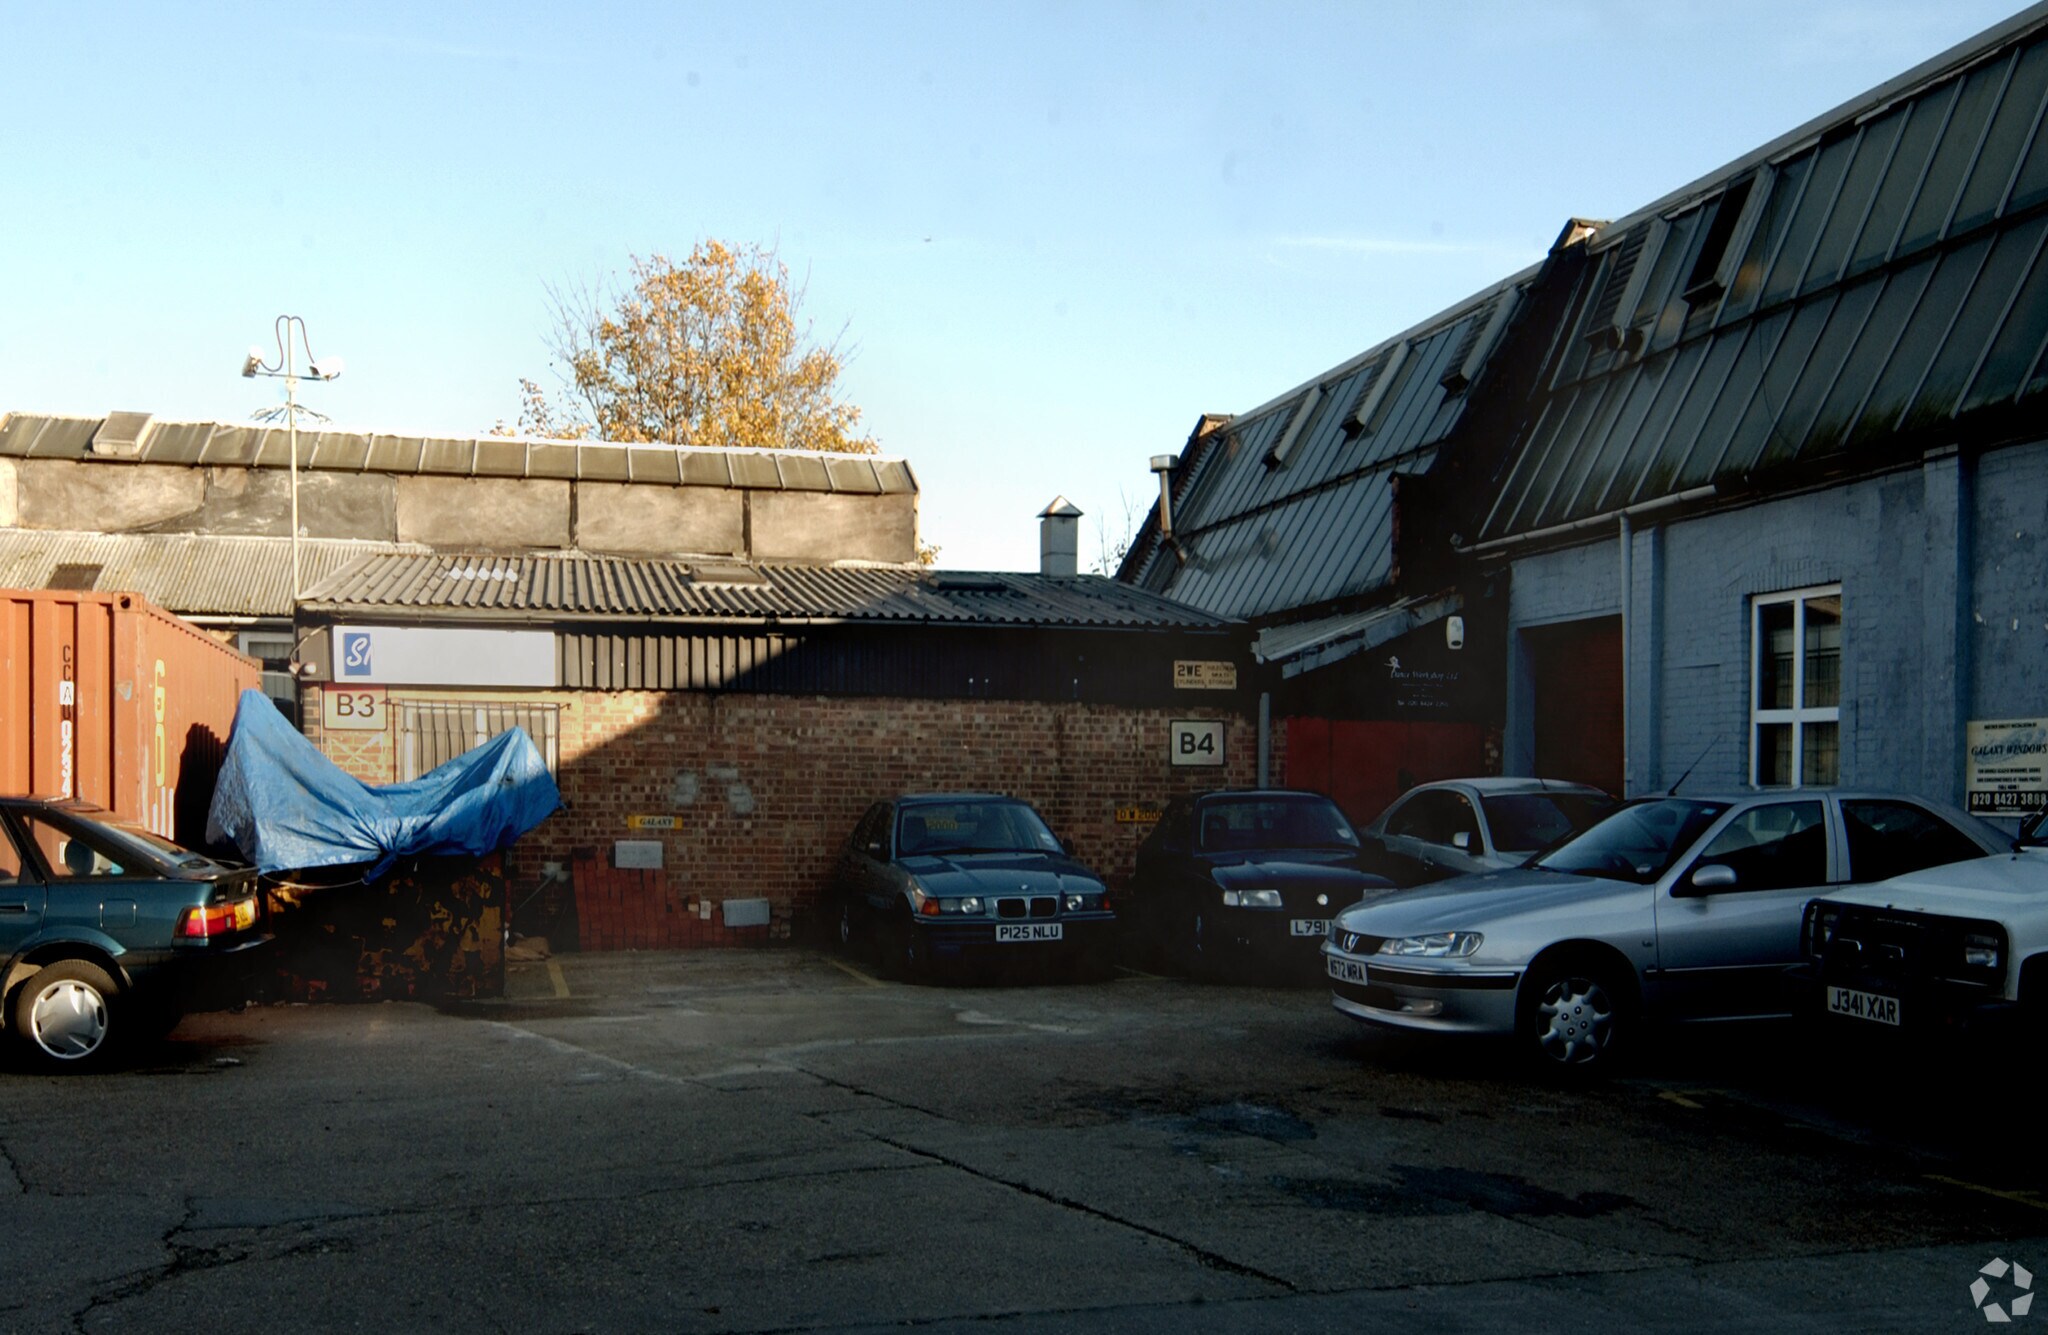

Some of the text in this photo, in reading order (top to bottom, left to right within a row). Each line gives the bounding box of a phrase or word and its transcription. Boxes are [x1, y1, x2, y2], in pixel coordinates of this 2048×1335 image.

[1177, 664, 1202, 677] 2WE
[337, 693, 375, 718] B3
[1180, 732, 1215, 755] B4
[1971, 743, 2048, 756] GALAXY WINDOWS
[1972, 792, 1991, 805] 020
[1994, 792, 2018, 805] 8427
[639, 817, 673, 826] GALAXY
[1000, 926, 1059, 939] P125 NLU
[1295, 921, 1326, 934] L791
[1832, 989, 1896, 1023] J341 XAR
